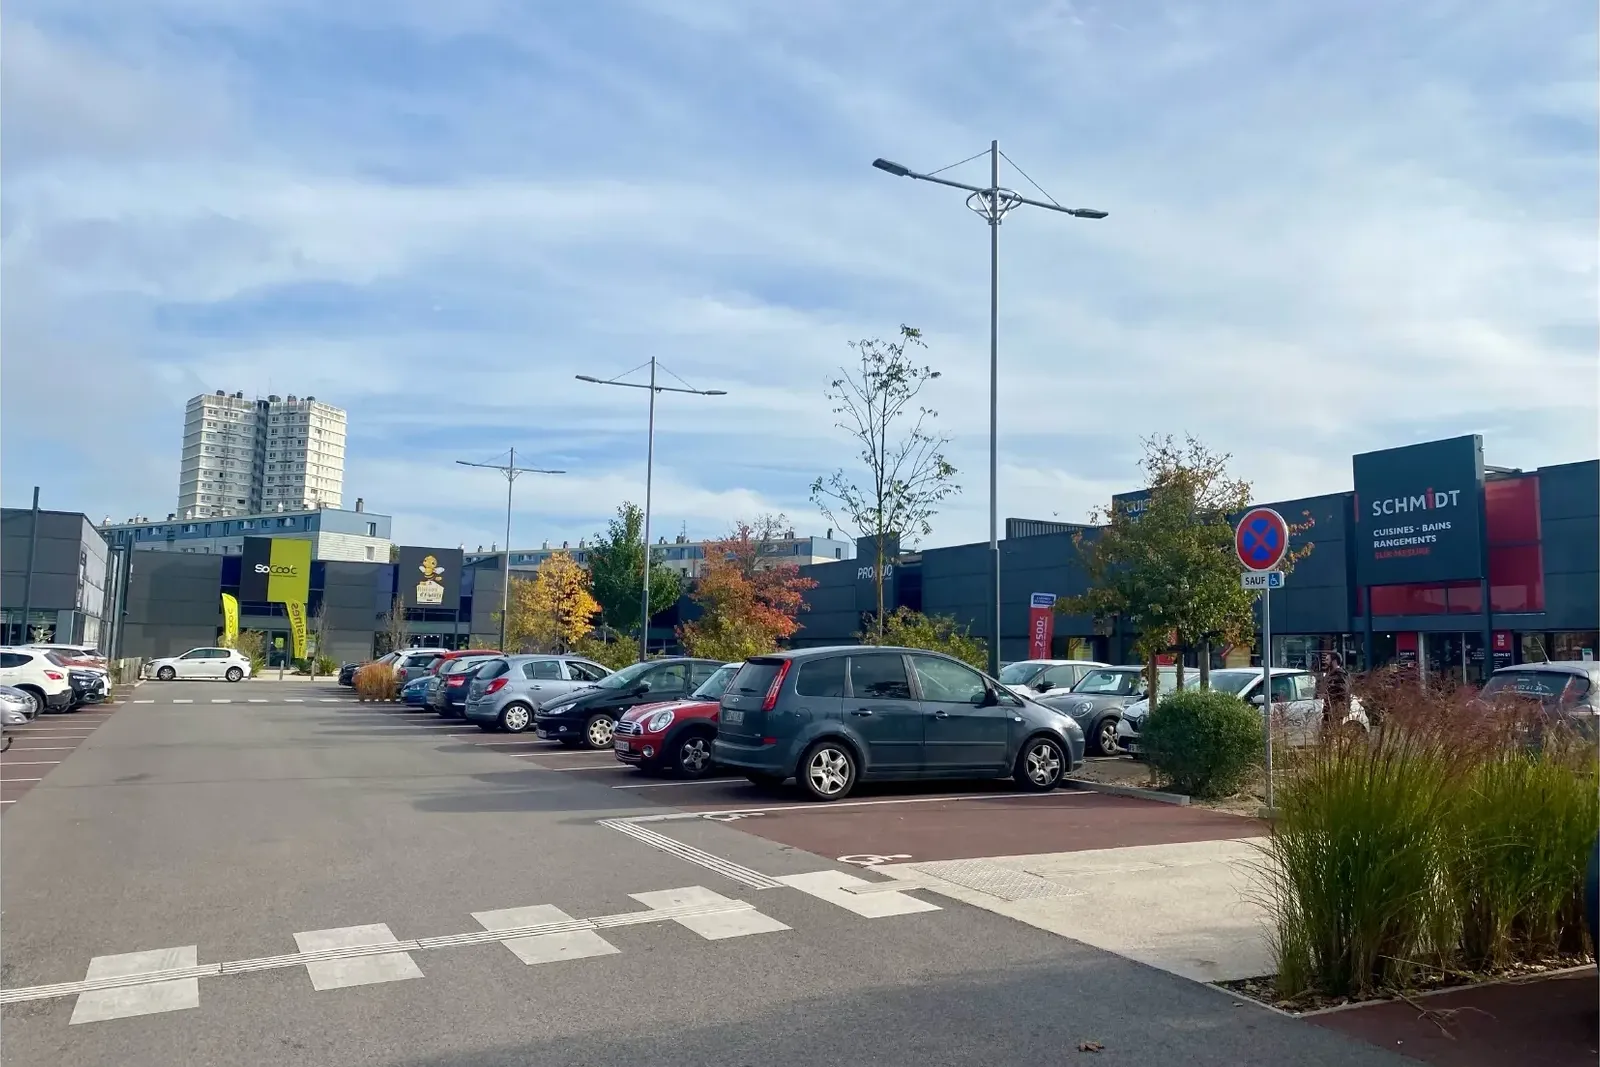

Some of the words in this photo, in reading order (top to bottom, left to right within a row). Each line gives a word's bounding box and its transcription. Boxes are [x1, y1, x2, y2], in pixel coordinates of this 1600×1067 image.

[1373, 525, 1414, 537] CUISINES
[1422, 521, 1452, 532] BAINS
[1373, 534, 1437, 548] RANGEMENTS
[857, 564, 893, 580] PROUO
[1245, 576, 1266, 586] SAUF
